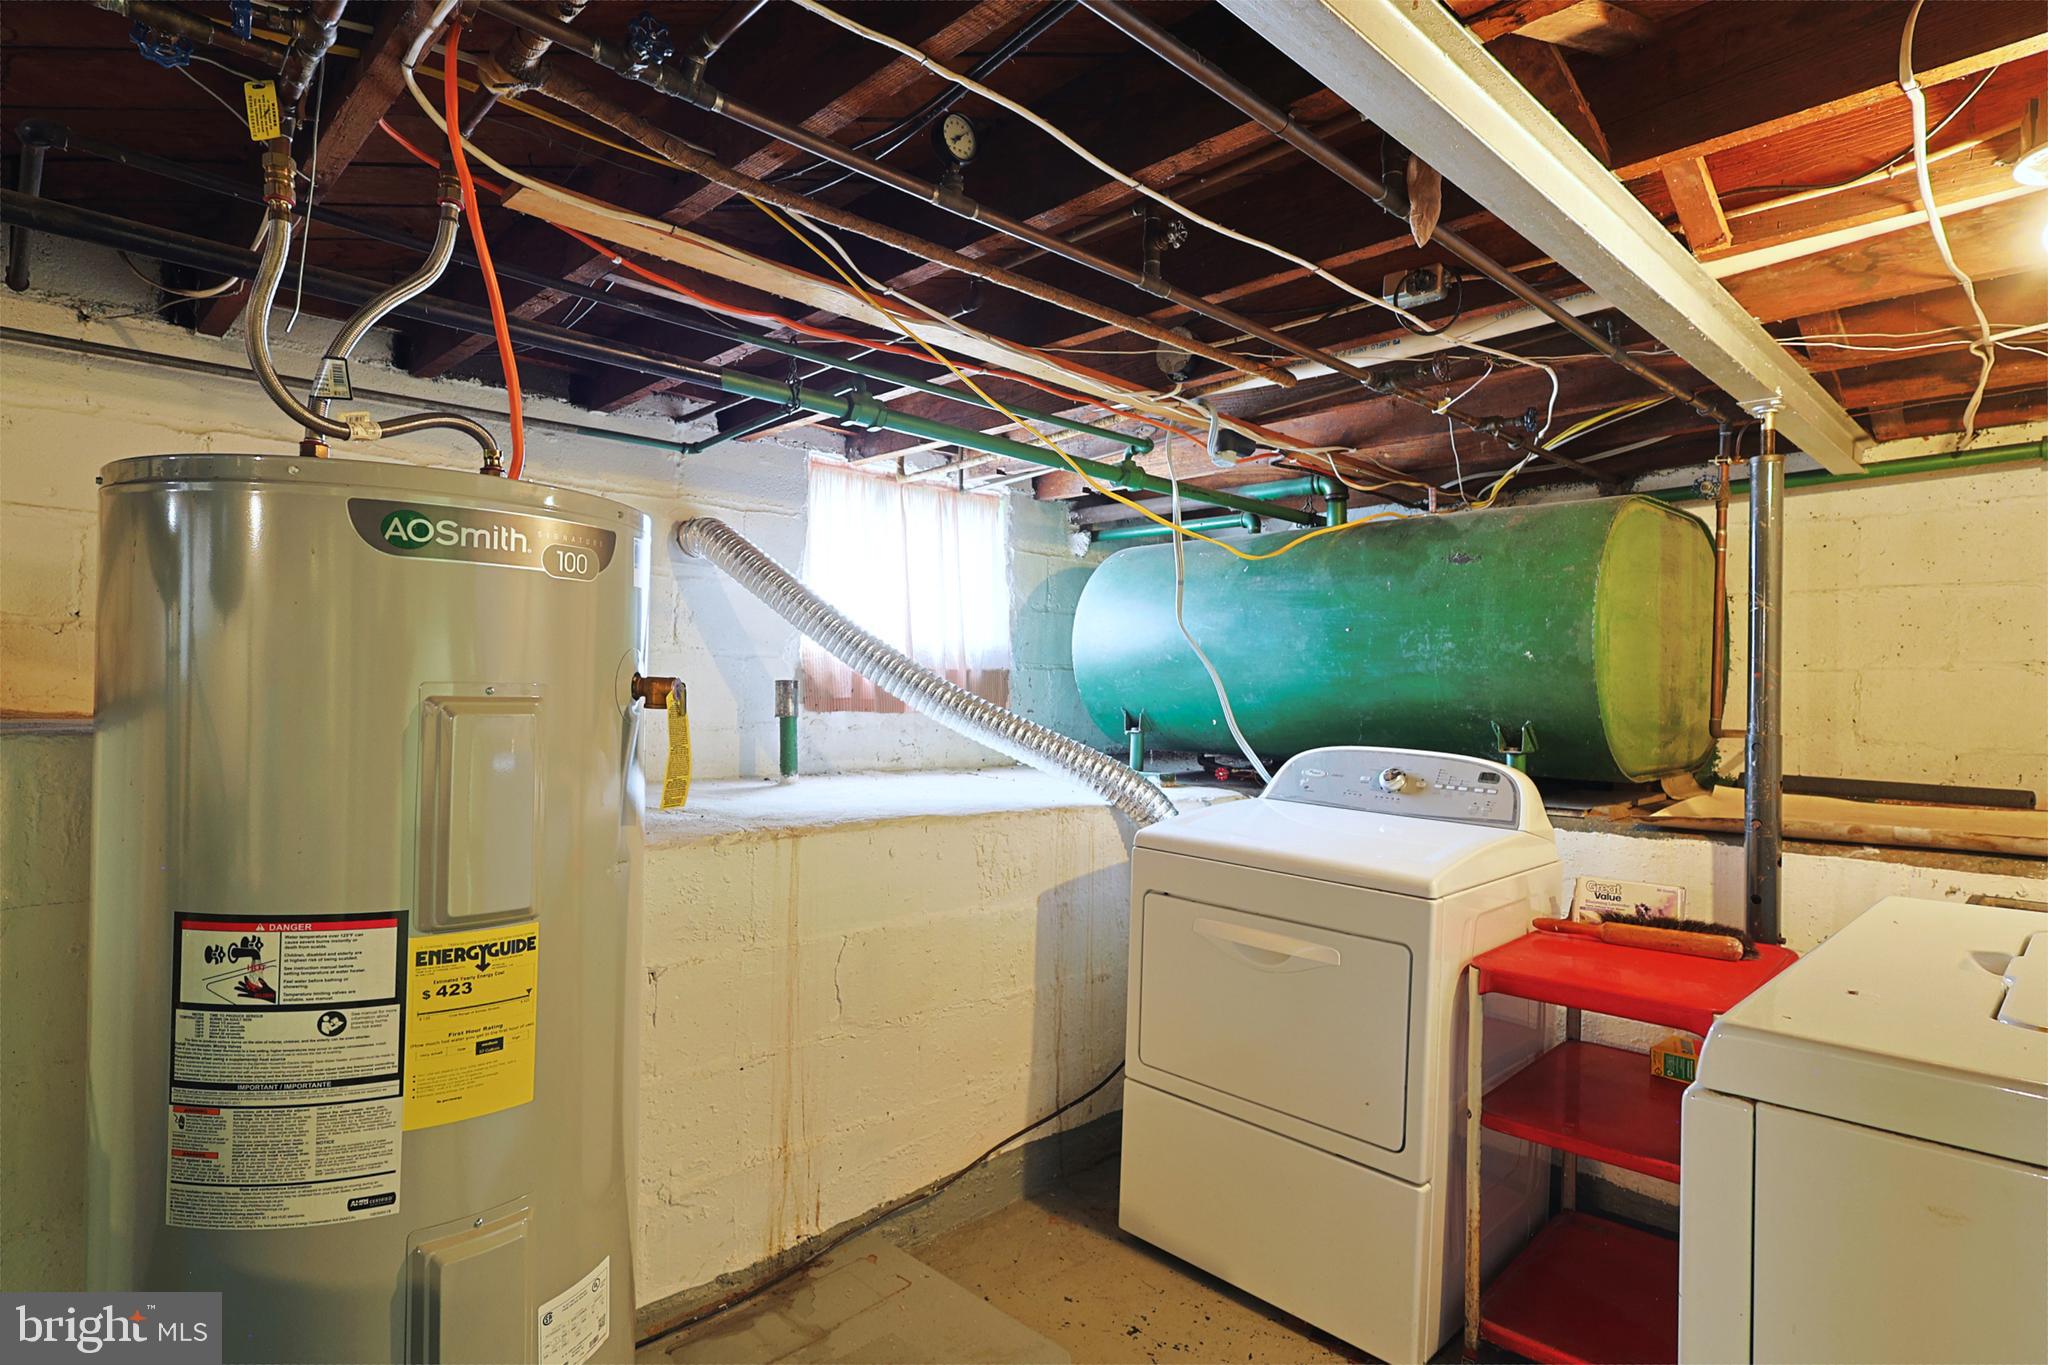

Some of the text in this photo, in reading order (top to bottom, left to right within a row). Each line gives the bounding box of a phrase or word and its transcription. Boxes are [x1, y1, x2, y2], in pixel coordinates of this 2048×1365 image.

[557, 551, 587, 573] 100
[1586, 880, 1621, 894] Great
[1594, 892, 1621, 901] Value
[416, 936, 536, 968] ENERGYGUIDE
[422, 982, 472, 1000] $ 423
